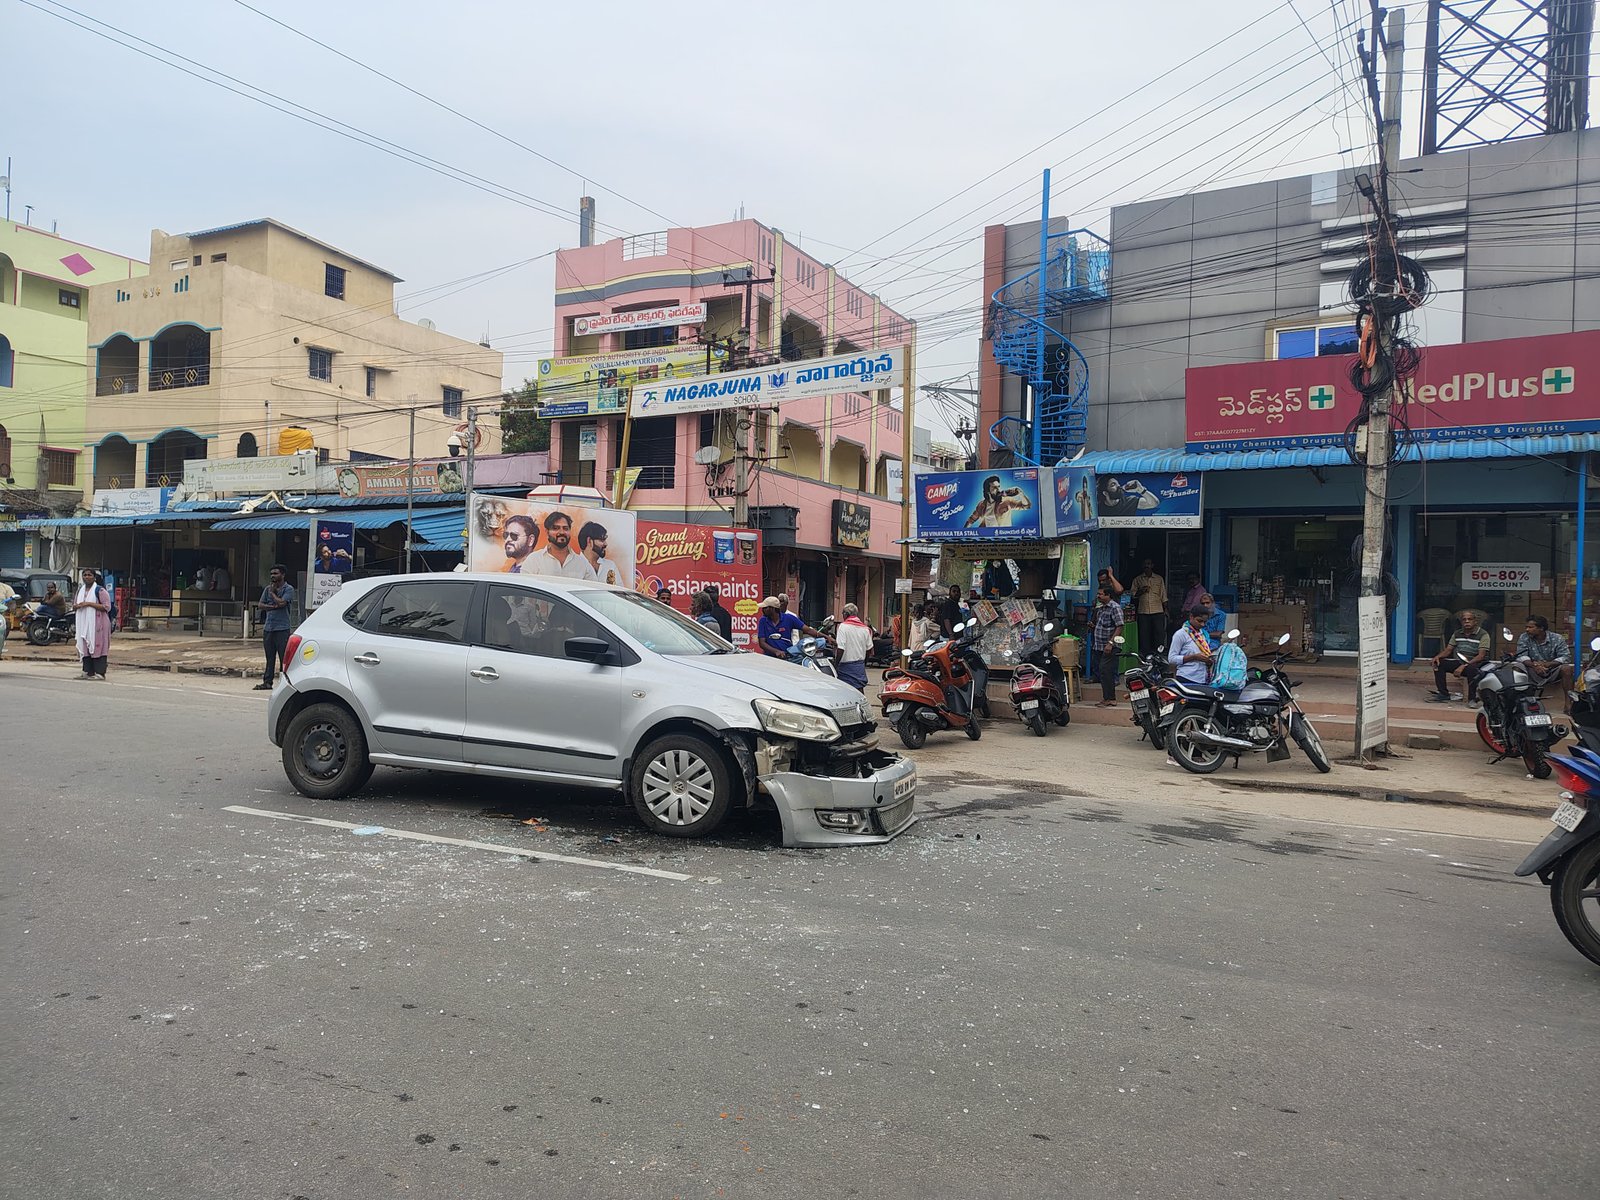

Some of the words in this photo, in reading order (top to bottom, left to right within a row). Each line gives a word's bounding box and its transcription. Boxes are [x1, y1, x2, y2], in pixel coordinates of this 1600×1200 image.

[554, 356, 583, 366] NATIONAL
[584, 353, 606, 363] SPORTS
[607, 350, 640, 361] AUTHORITY
[631, 357, 667, 366] WARRIORS
[796, 353, 893, 383] నాగార్జున
[664, 376, 761, 403] NAGARJUNA
[1393, 372, 1539, 405] MedPlus
[733, 394, 760, 406] SCHOOL
[1438, 428, 1488, 437] Chemists
[1508, 424, 1566, 434] Druggists
[1204, 442, 1237, 450] Quality
[1242, 439, 1286, 448] Chemists
[366, 477, 403, 488] AMARA
[927, 482, 958, 500] CAMPA
[646, 528, 688, 546] Grand
[636, 541, 708, 566] Opening
[1472, 570, 1530, 580] 50-80%
[732, 616, 758, 630] RISES
